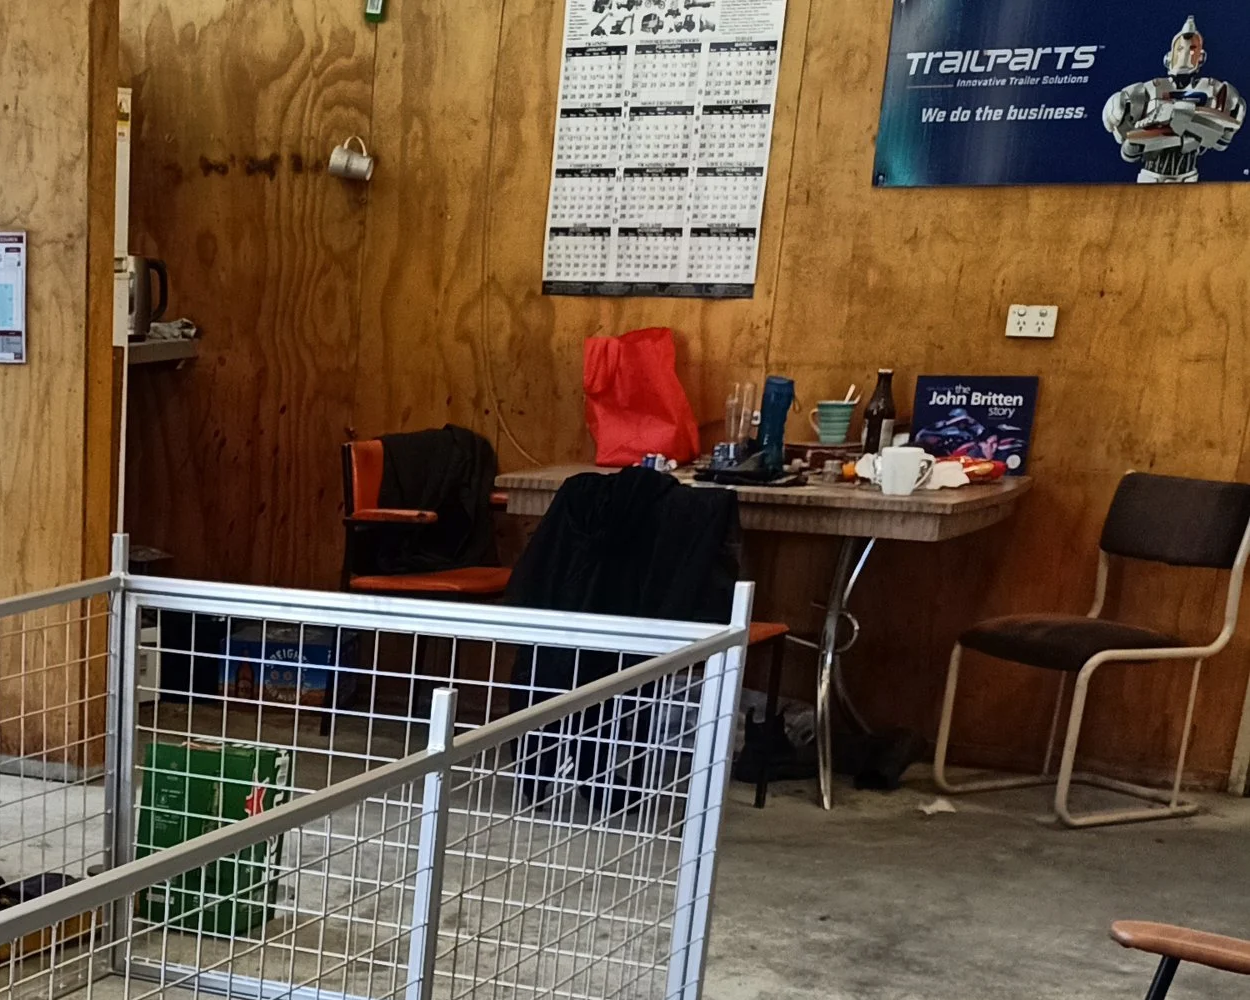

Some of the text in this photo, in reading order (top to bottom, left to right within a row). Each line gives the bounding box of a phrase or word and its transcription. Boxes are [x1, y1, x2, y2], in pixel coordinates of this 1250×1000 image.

[956, 74, 1089, 88] Innovative Trailer Solutions
[922, 108, 946, 123] We
[950, 106, 970, 122] do
[975, 105, 1003, 121] the
[955, 384, 970, 394] the
[929, 390, 1023, 406] John Britten
[988, 406, 1015, 418] story
